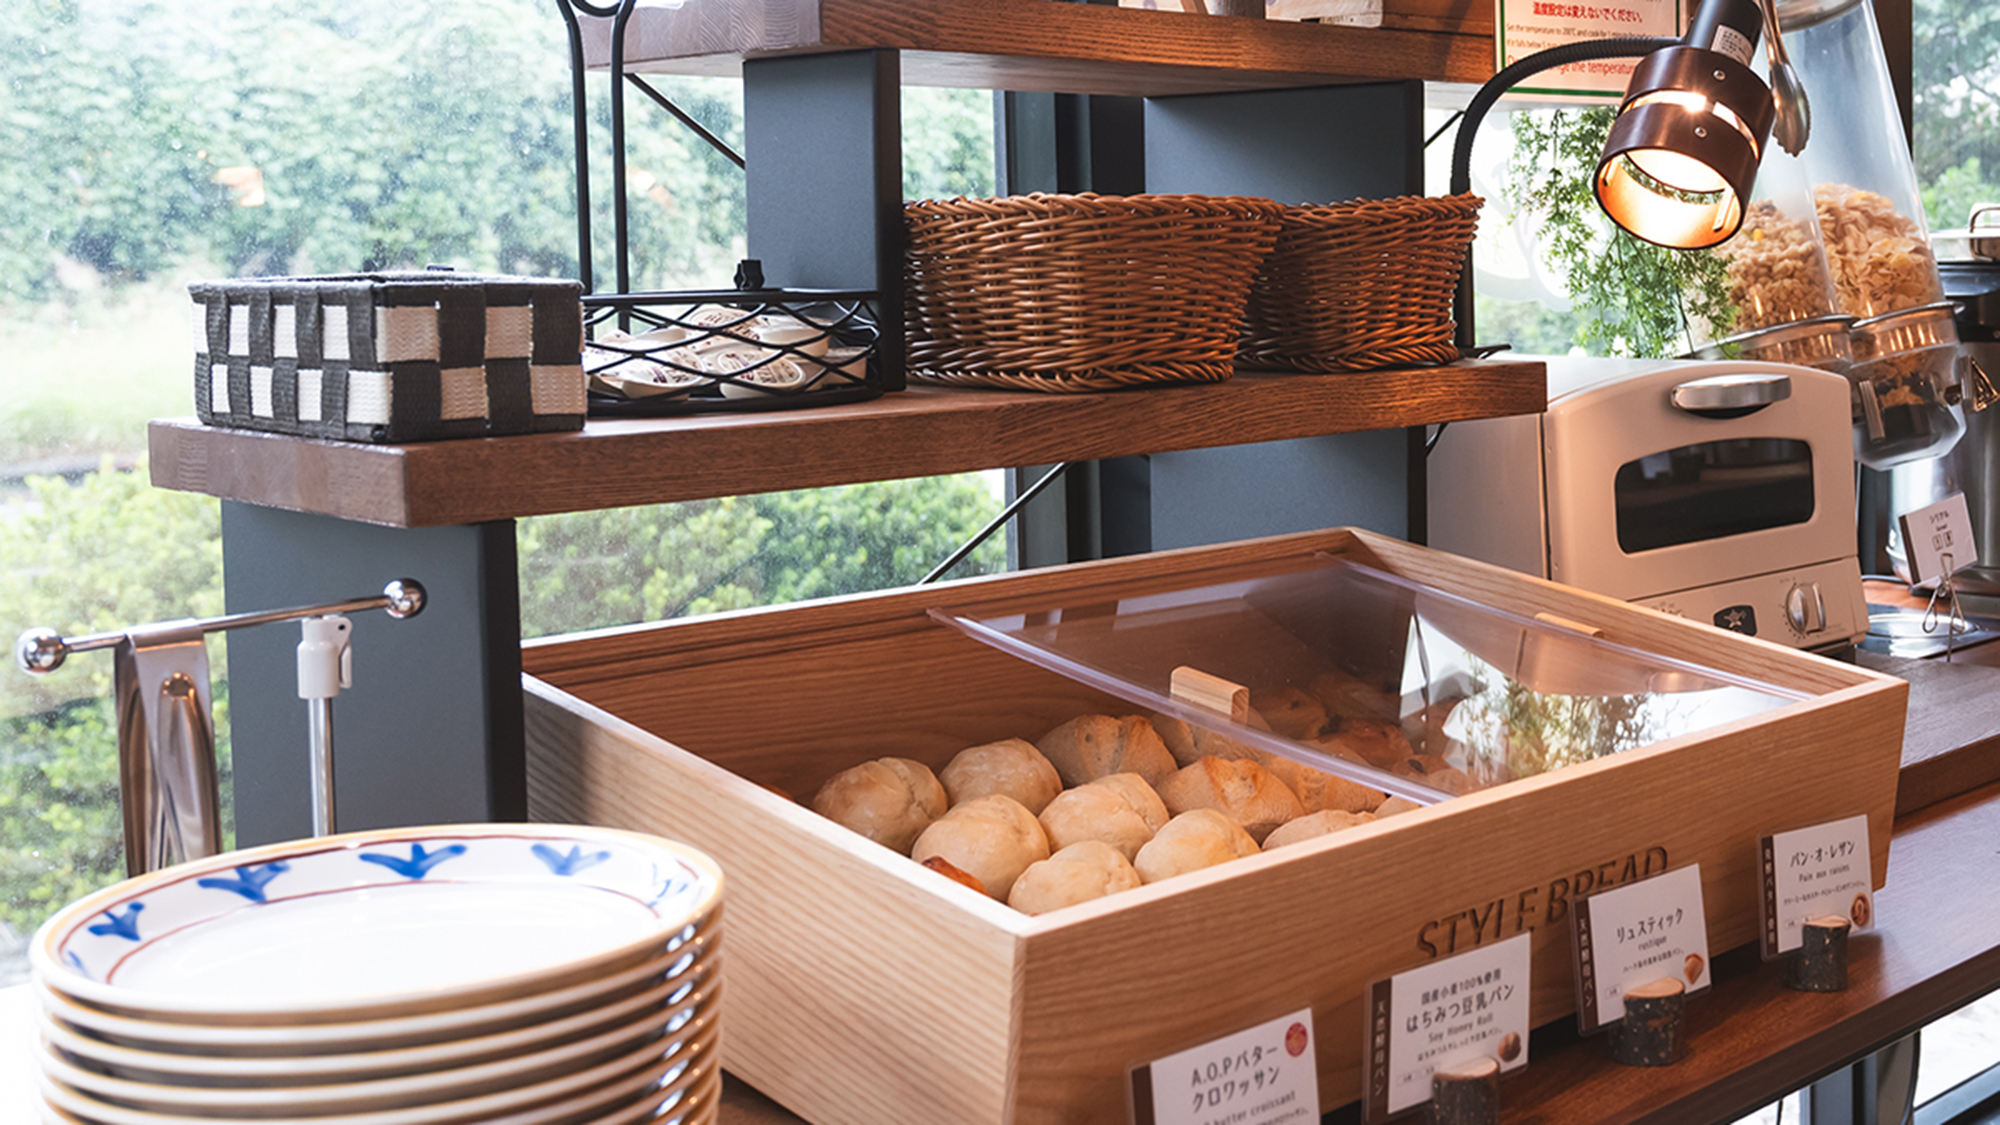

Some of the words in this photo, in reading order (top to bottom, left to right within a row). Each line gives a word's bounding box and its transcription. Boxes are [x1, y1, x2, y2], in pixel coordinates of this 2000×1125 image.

[1533, 1, 1643, 23] 温度設定は変えないでください。
[1416, 886, 1538, 959] STYLE
[1617, 908, 1683, 944] リュスティック
[1421, 968, 1502, 1006] 国産小麦100%使用
[1406, 984, 1514, 1033] はちみつ豆乳パン
[1428, 1032, 1444, 1044] Soy
[1447, 1022, 1473, 1036] Honey
[1191, 1045, 1278, 1088] A.O.Pバター
[1192, 1066, 1280, 1114] クロワッサン
[1250, 1090, 1296, 1116] croissant
